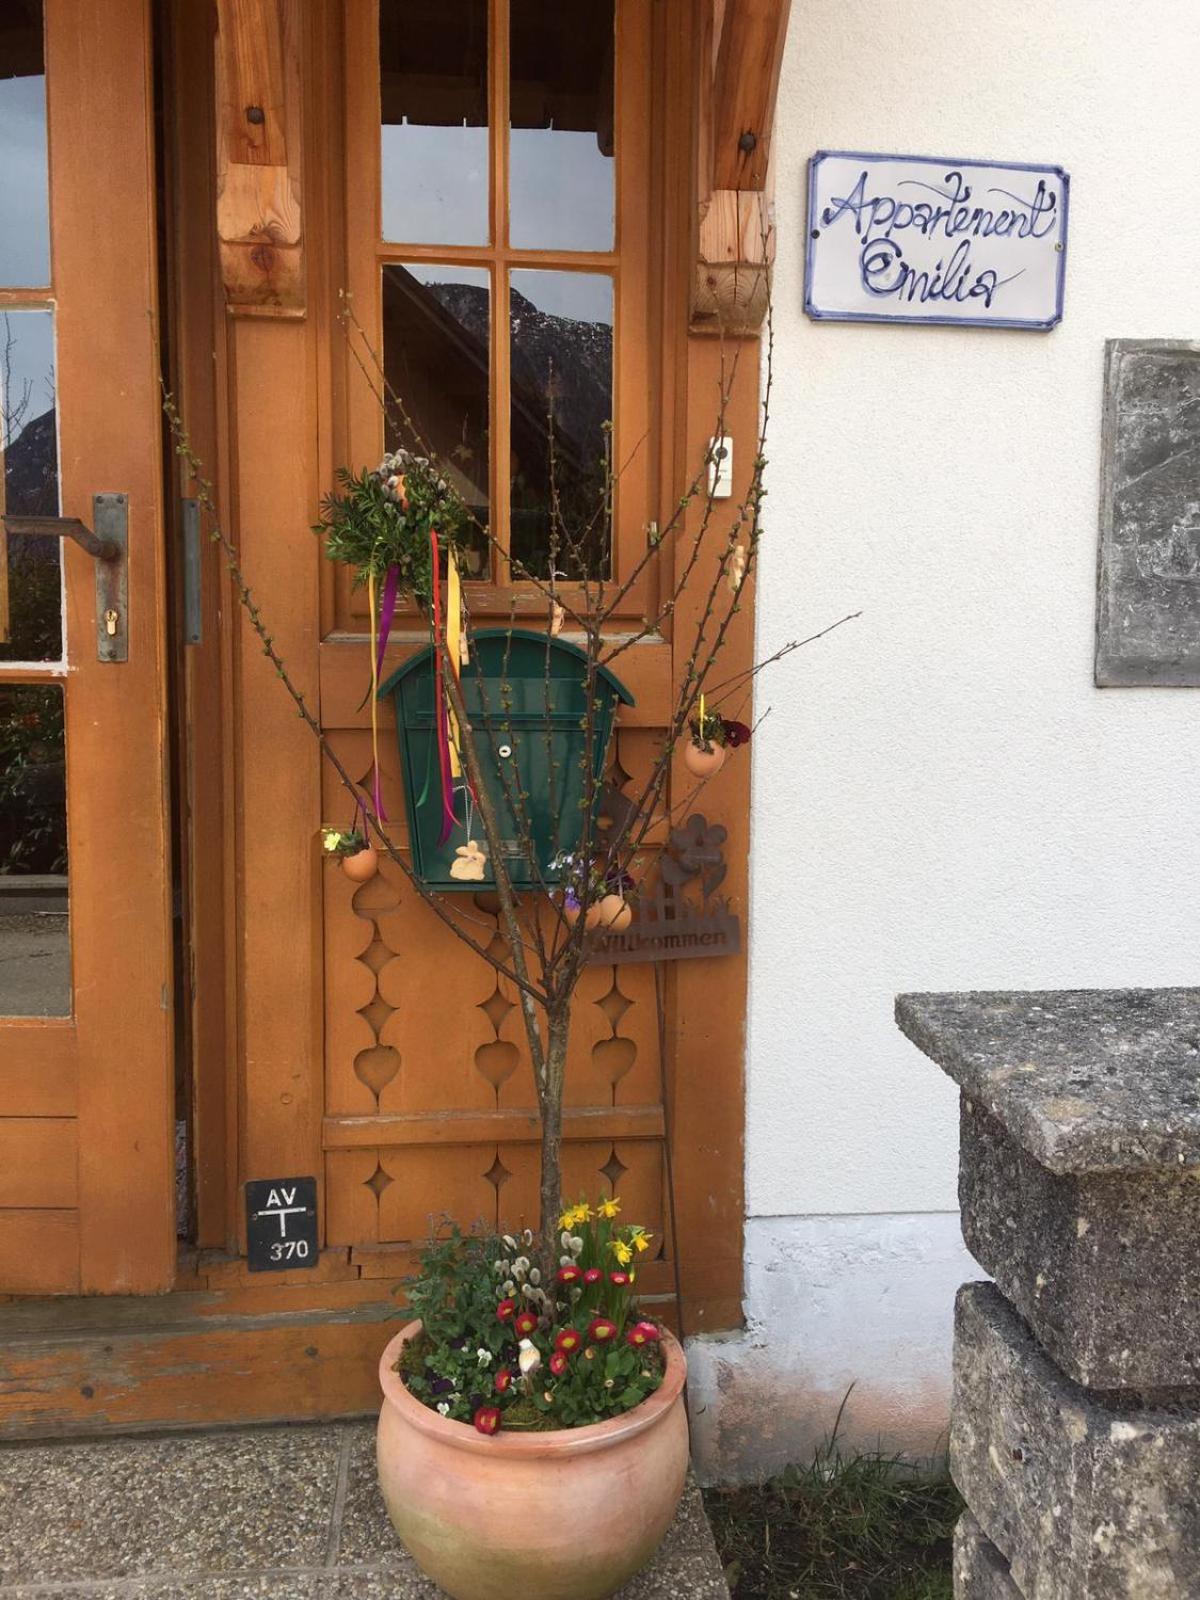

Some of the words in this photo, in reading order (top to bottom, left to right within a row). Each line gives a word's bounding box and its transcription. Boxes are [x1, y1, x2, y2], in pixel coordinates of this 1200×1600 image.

[861, 238, 1026, 308] Emilia
[266, 1187, 297, 1208] AV
[270, 1240, 309, 1261] 370
